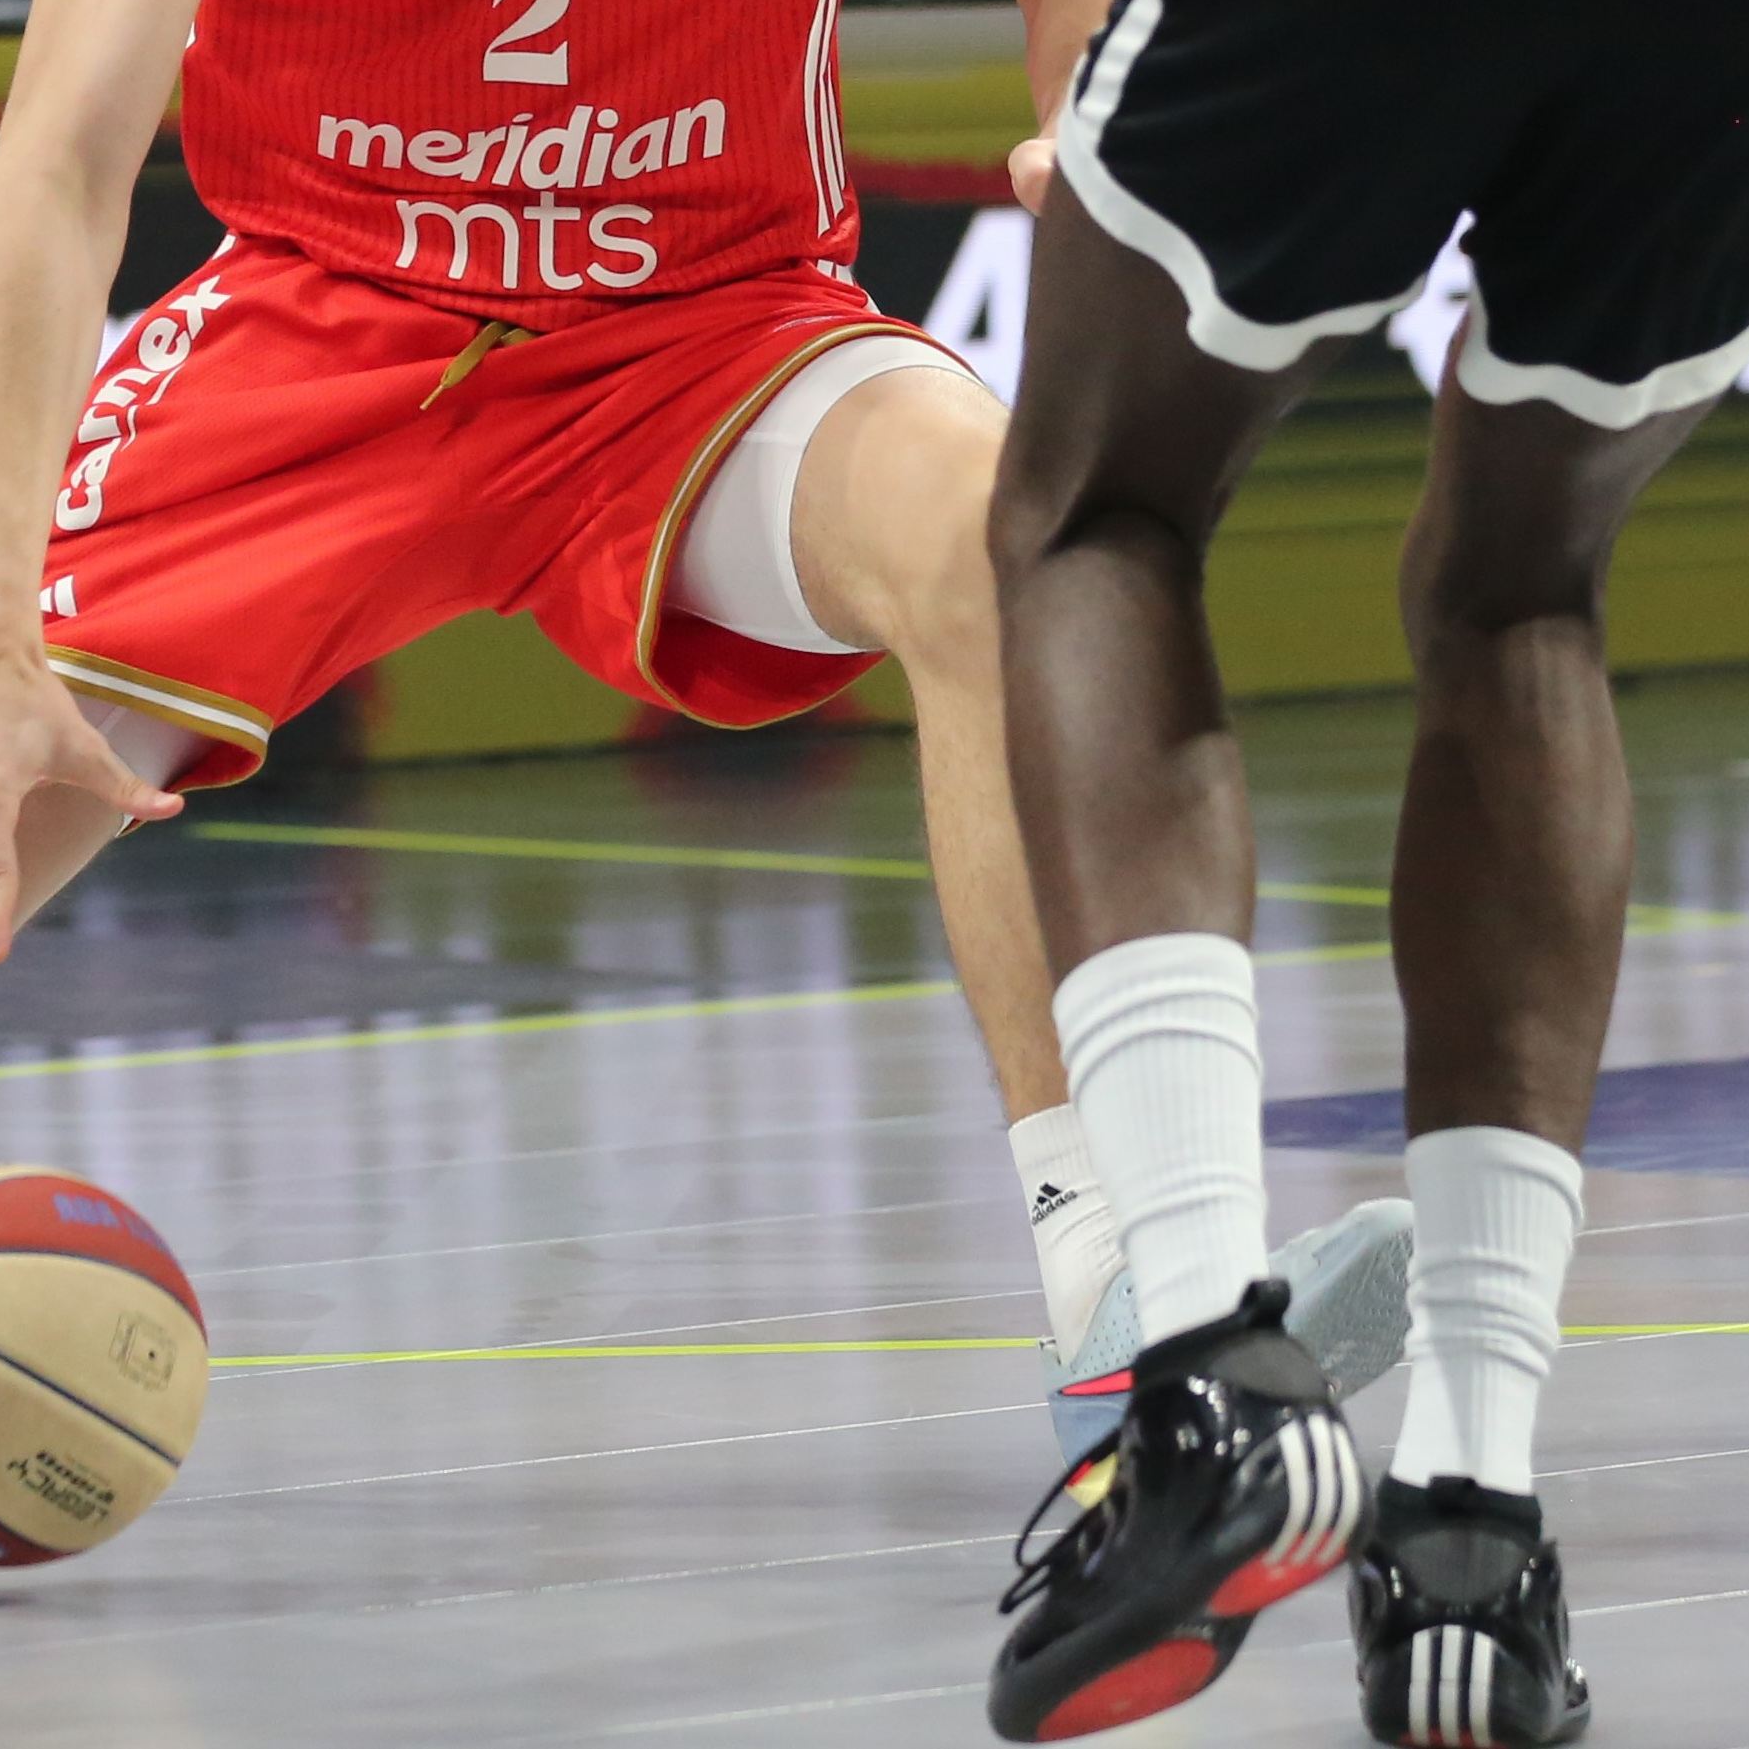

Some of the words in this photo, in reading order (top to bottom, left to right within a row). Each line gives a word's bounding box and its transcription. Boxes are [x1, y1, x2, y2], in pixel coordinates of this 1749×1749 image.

[317, 98, 727, 190] meridian
[394, 191, 659, 292] mts
[55, 273, 233, 532] carnex
